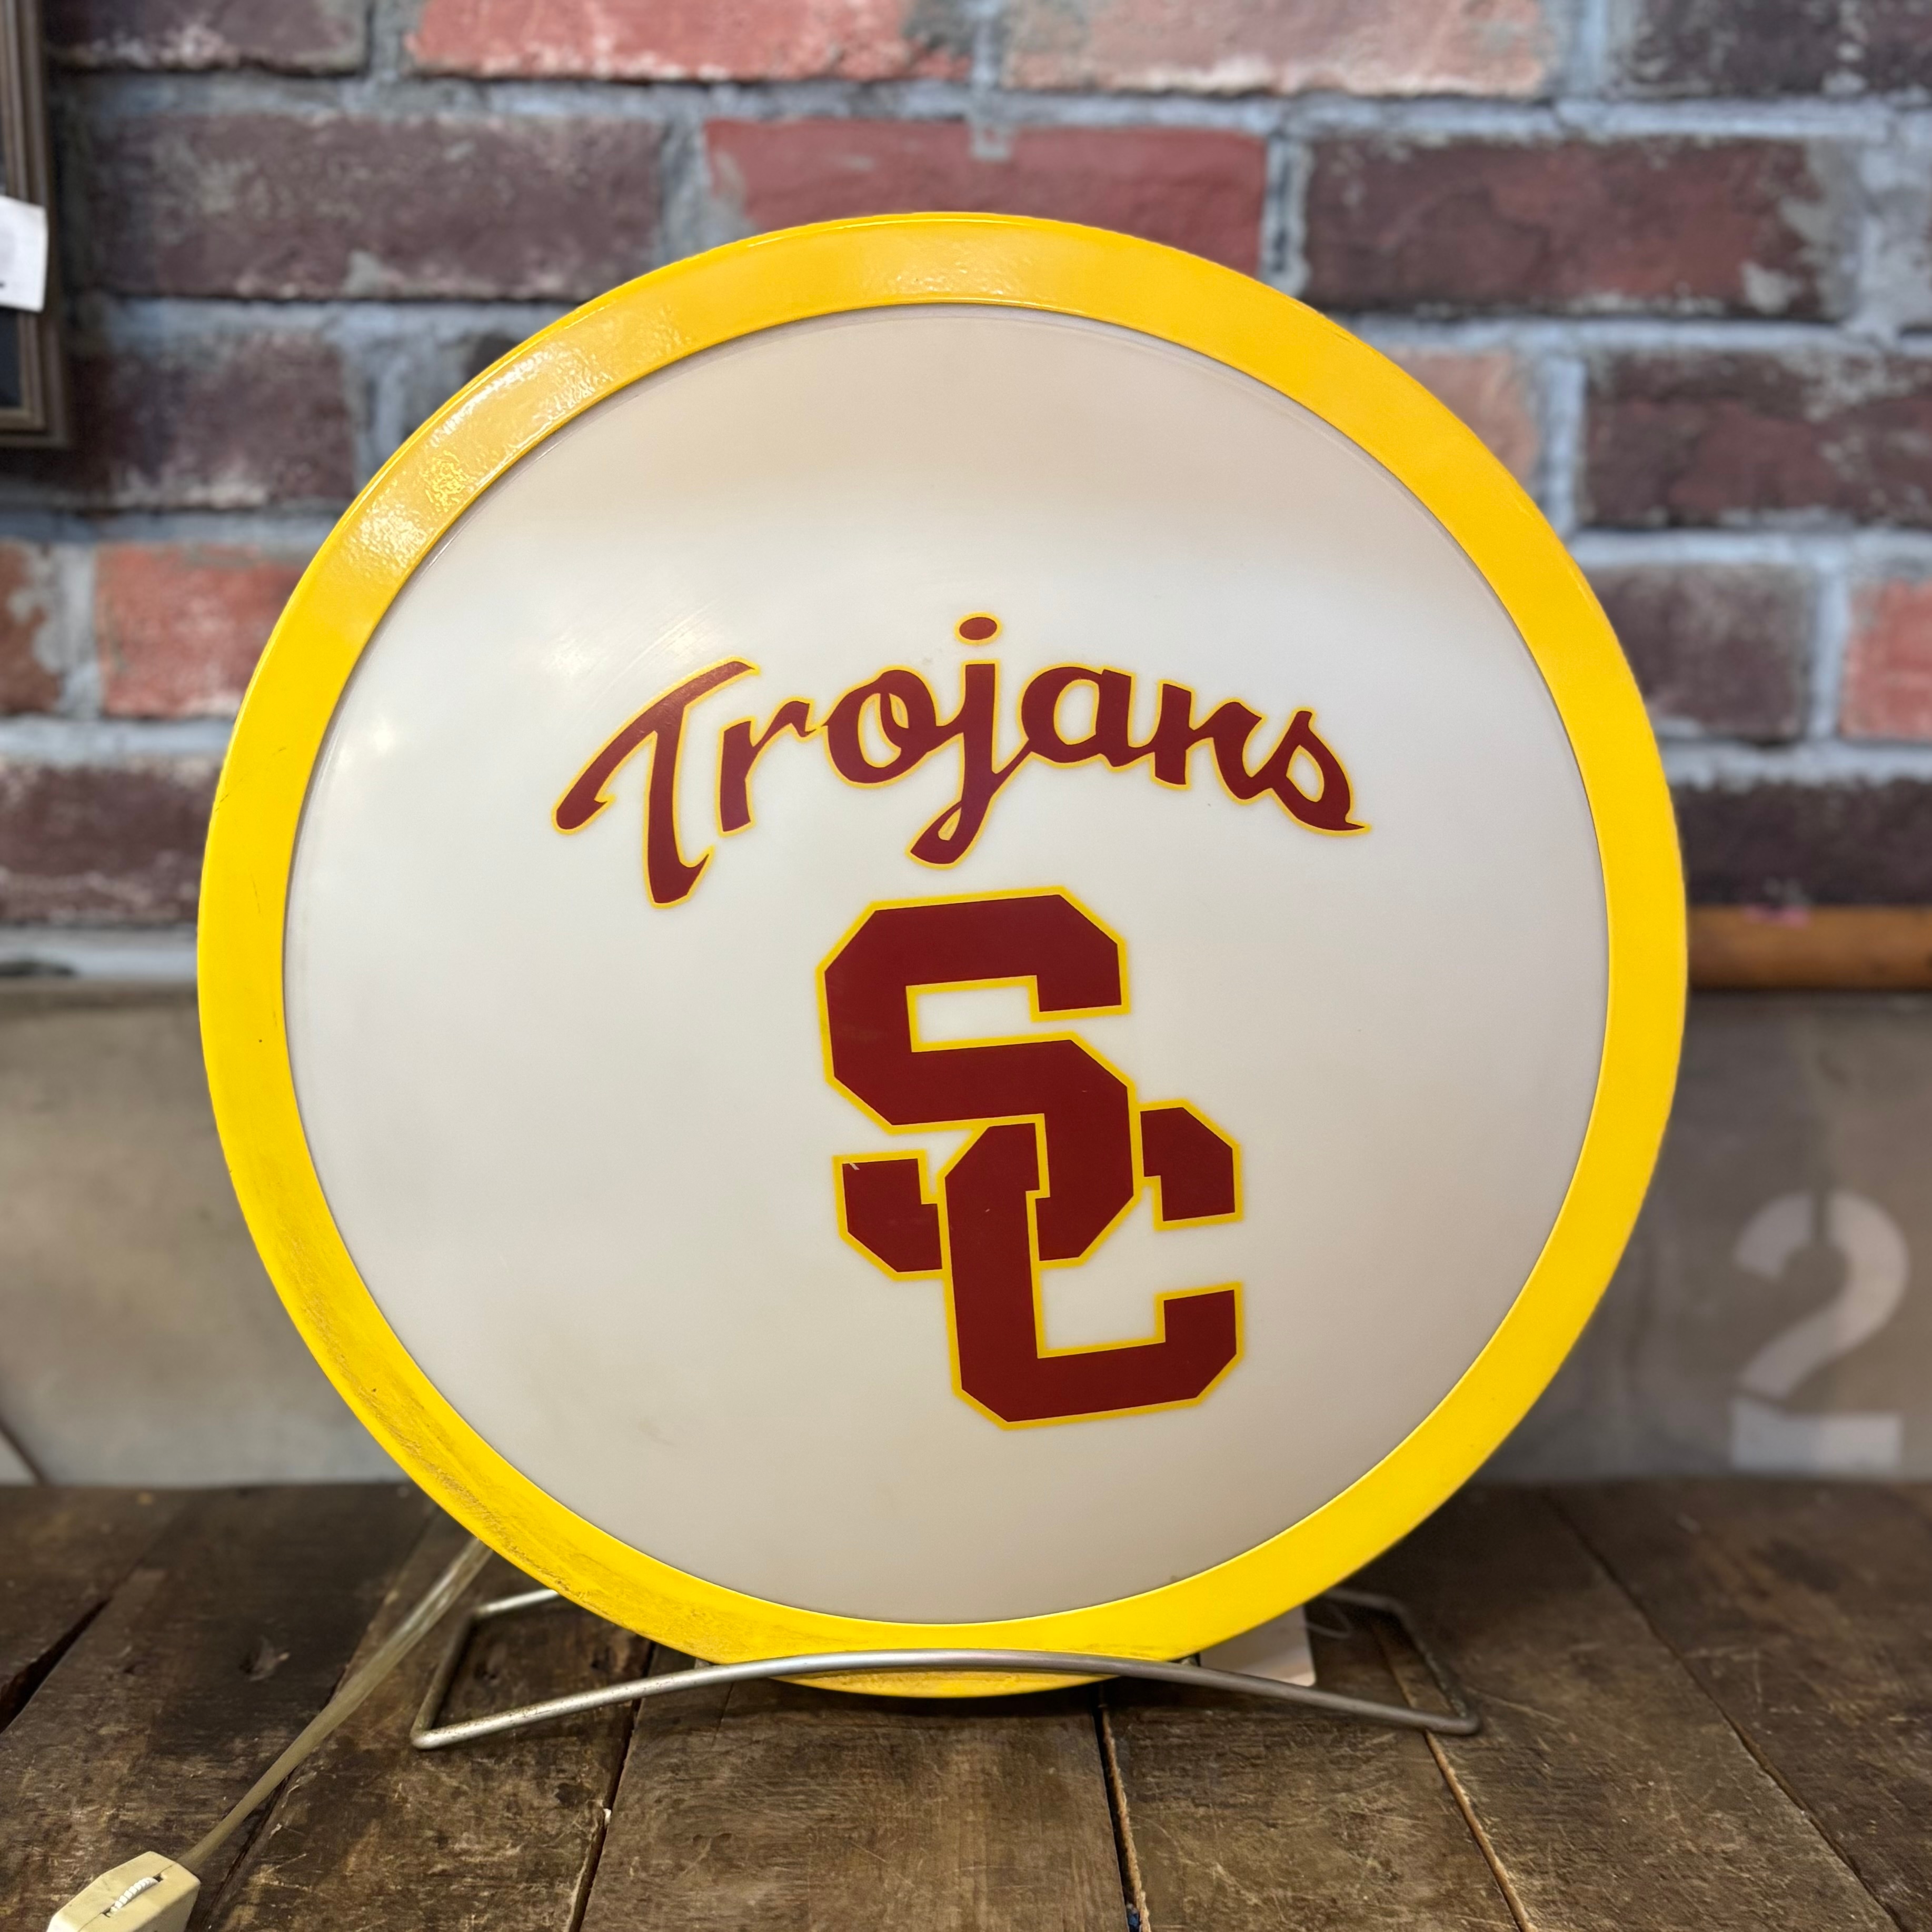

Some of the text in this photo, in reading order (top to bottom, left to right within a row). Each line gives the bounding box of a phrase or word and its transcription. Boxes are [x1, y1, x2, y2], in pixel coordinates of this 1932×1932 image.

[552, 613, 1372, 908] Trojans
[816, 886, 1244, 1431] SC
[1731, 1188, 1911, 1472] 2
